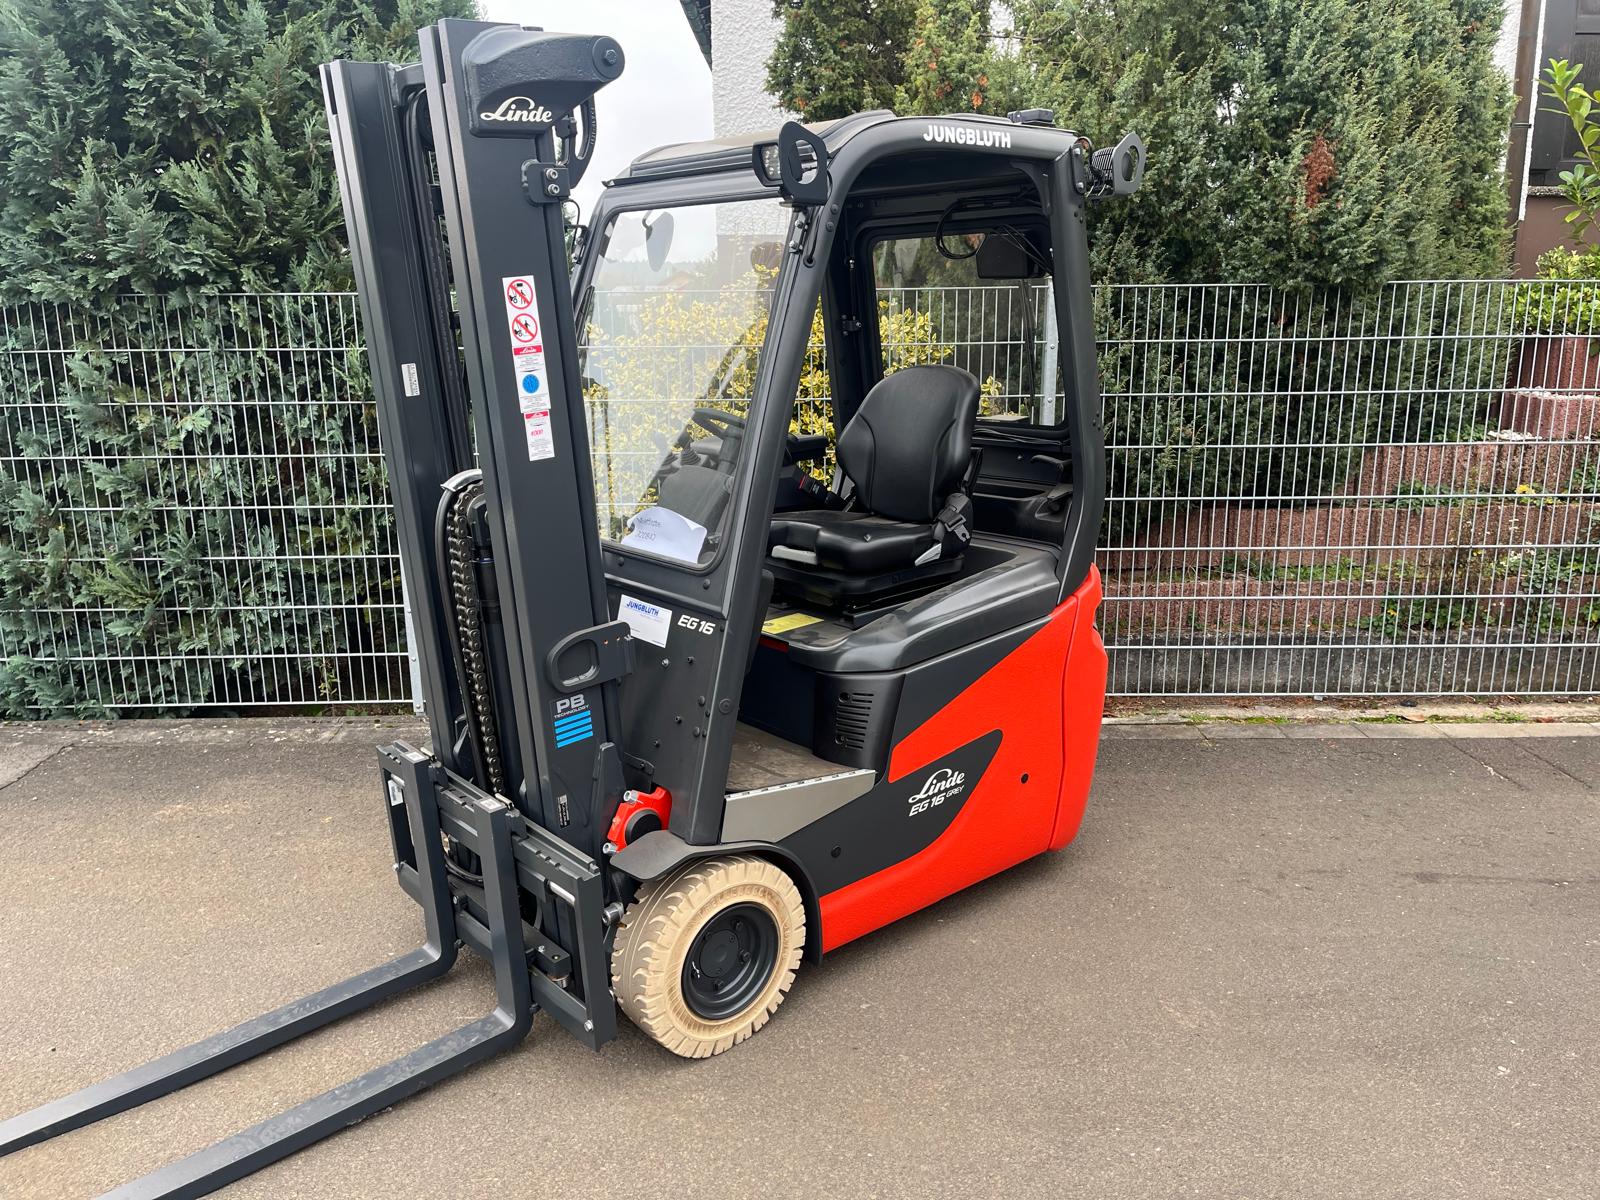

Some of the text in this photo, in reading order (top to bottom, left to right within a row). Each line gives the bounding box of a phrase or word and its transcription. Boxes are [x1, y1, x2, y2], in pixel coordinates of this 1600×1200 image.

[480, 96, 552, 123] Linde
[923, 125, 1011, 148] JUNGBLUTH
[627, 601, 660, 616] JUNGBLUTH
[678, 614, 700, 630] EG
[699, 620, 716, 635] 16
[554, 704, 589, 718] TECHNOLOGY
[556, 694, 585, 713] PB
[908, 768, 965, 803] Linde
[908, 785, 965, 817] EG 16 GREY
